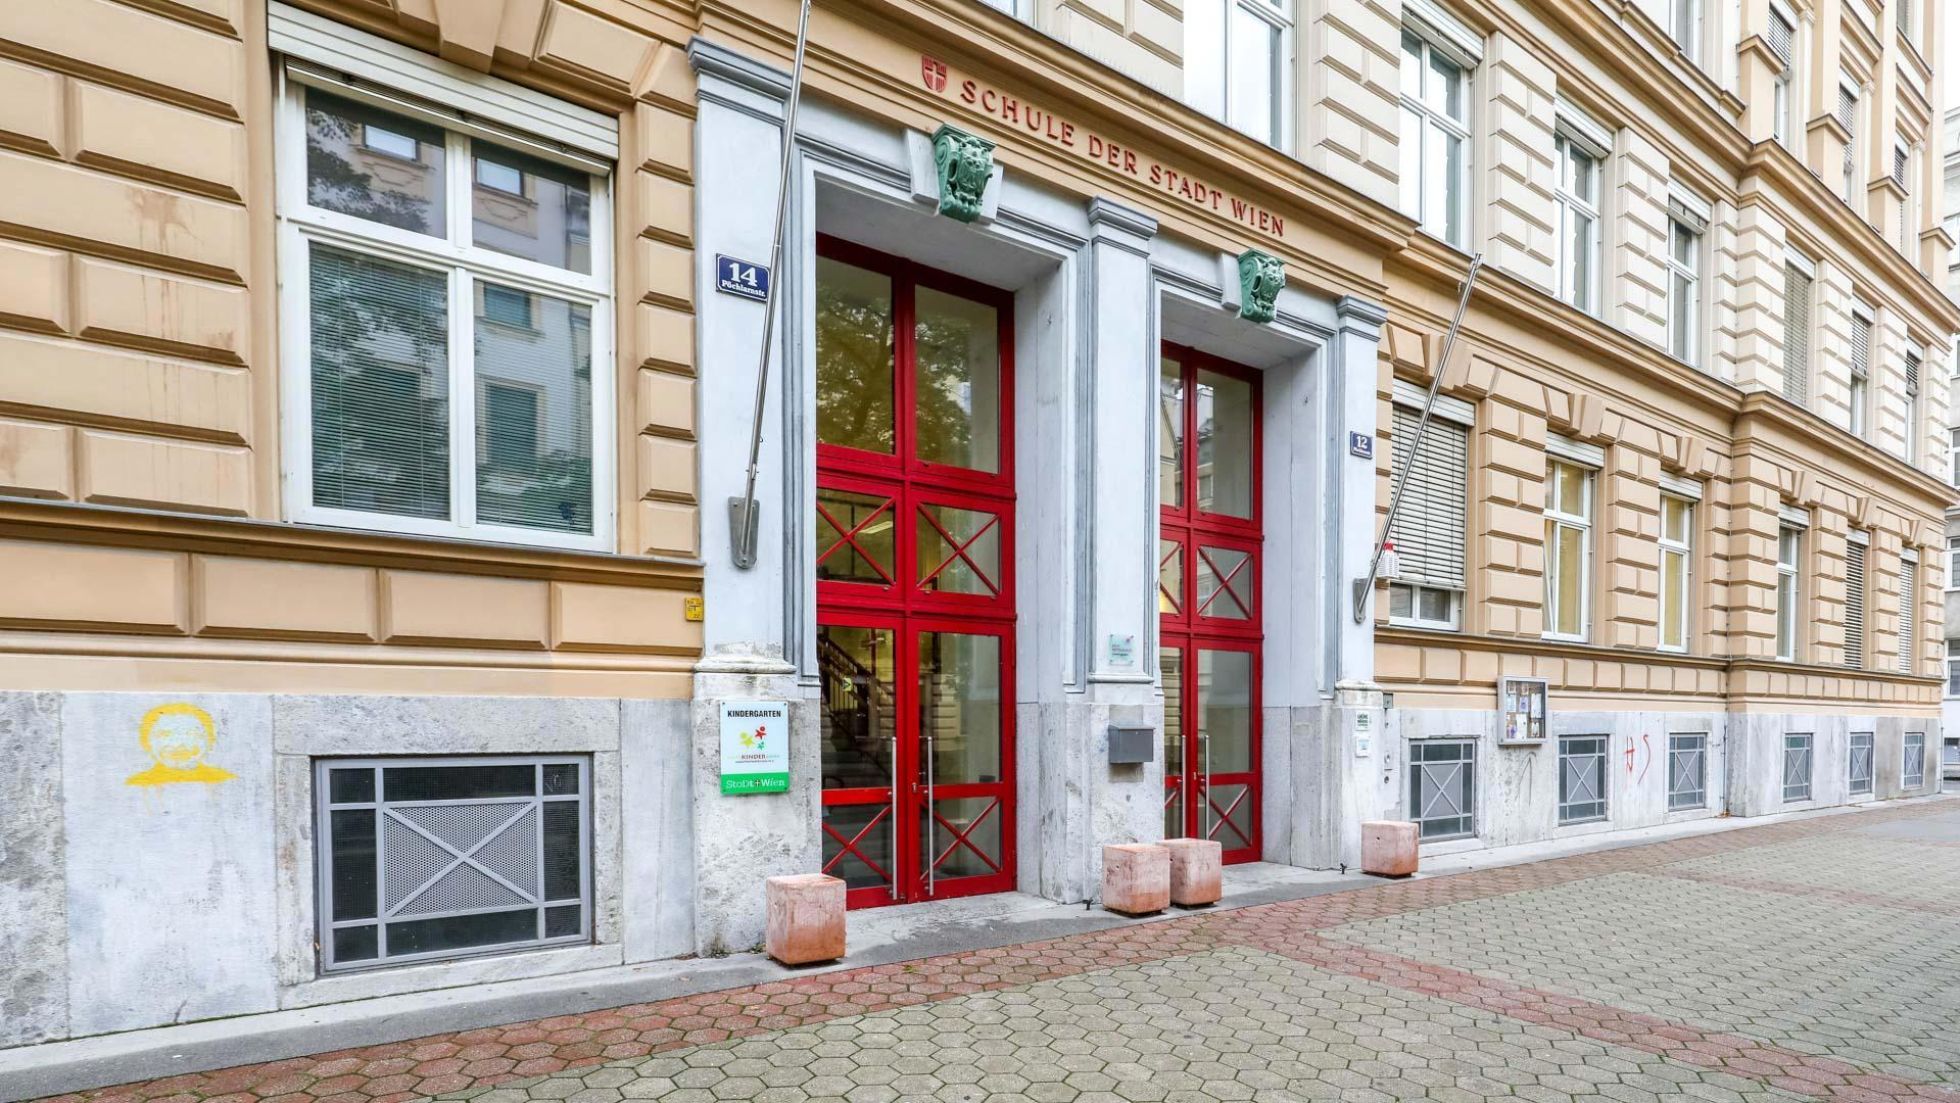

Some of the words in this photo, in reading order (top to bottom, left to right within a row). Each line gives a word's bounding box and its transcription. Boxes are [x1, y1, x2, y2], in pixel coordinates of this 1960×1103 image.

[961, 79, 1075, 147] SCHULE
[1089, 134, 1137, 175] DER
[1149, 163, 1223, 210] STADT
[1230, 197, 1284, 238] WIEN
[729, 262, 757, 287] 14
[1356, 435, 1368, 450] 12
[760, 777, 785, 787] Wien
